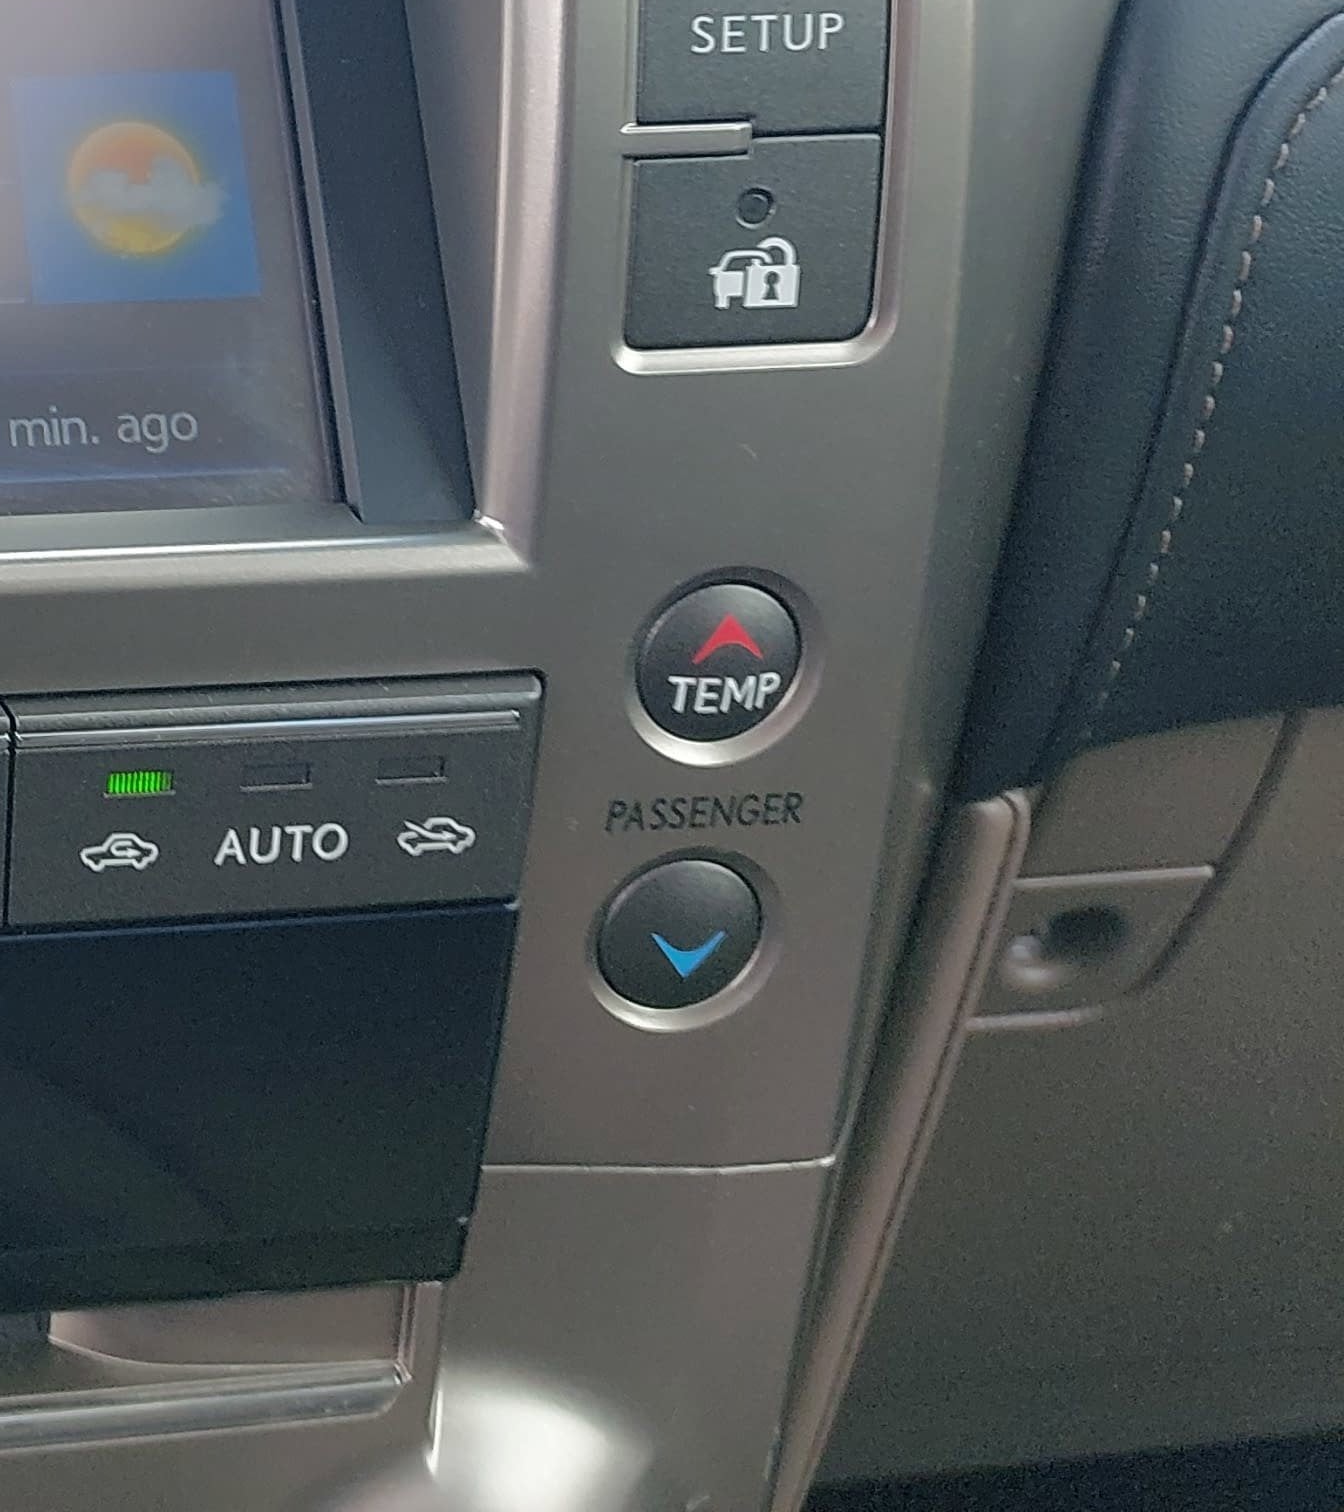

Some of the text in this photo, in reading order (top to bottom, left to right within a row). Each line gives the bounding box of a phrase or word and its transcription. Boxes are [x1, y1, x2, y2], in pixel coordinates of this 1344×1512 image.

[690, 12, 845, 55] SETUP
[8, 402, 101, 449] min.
[116, 406, 200, 454] ago
[667, 671, 783, 715] TEMP
[604, 791, 805, 836] PASSENGER
[213, 822, 351, 867] AUTO
